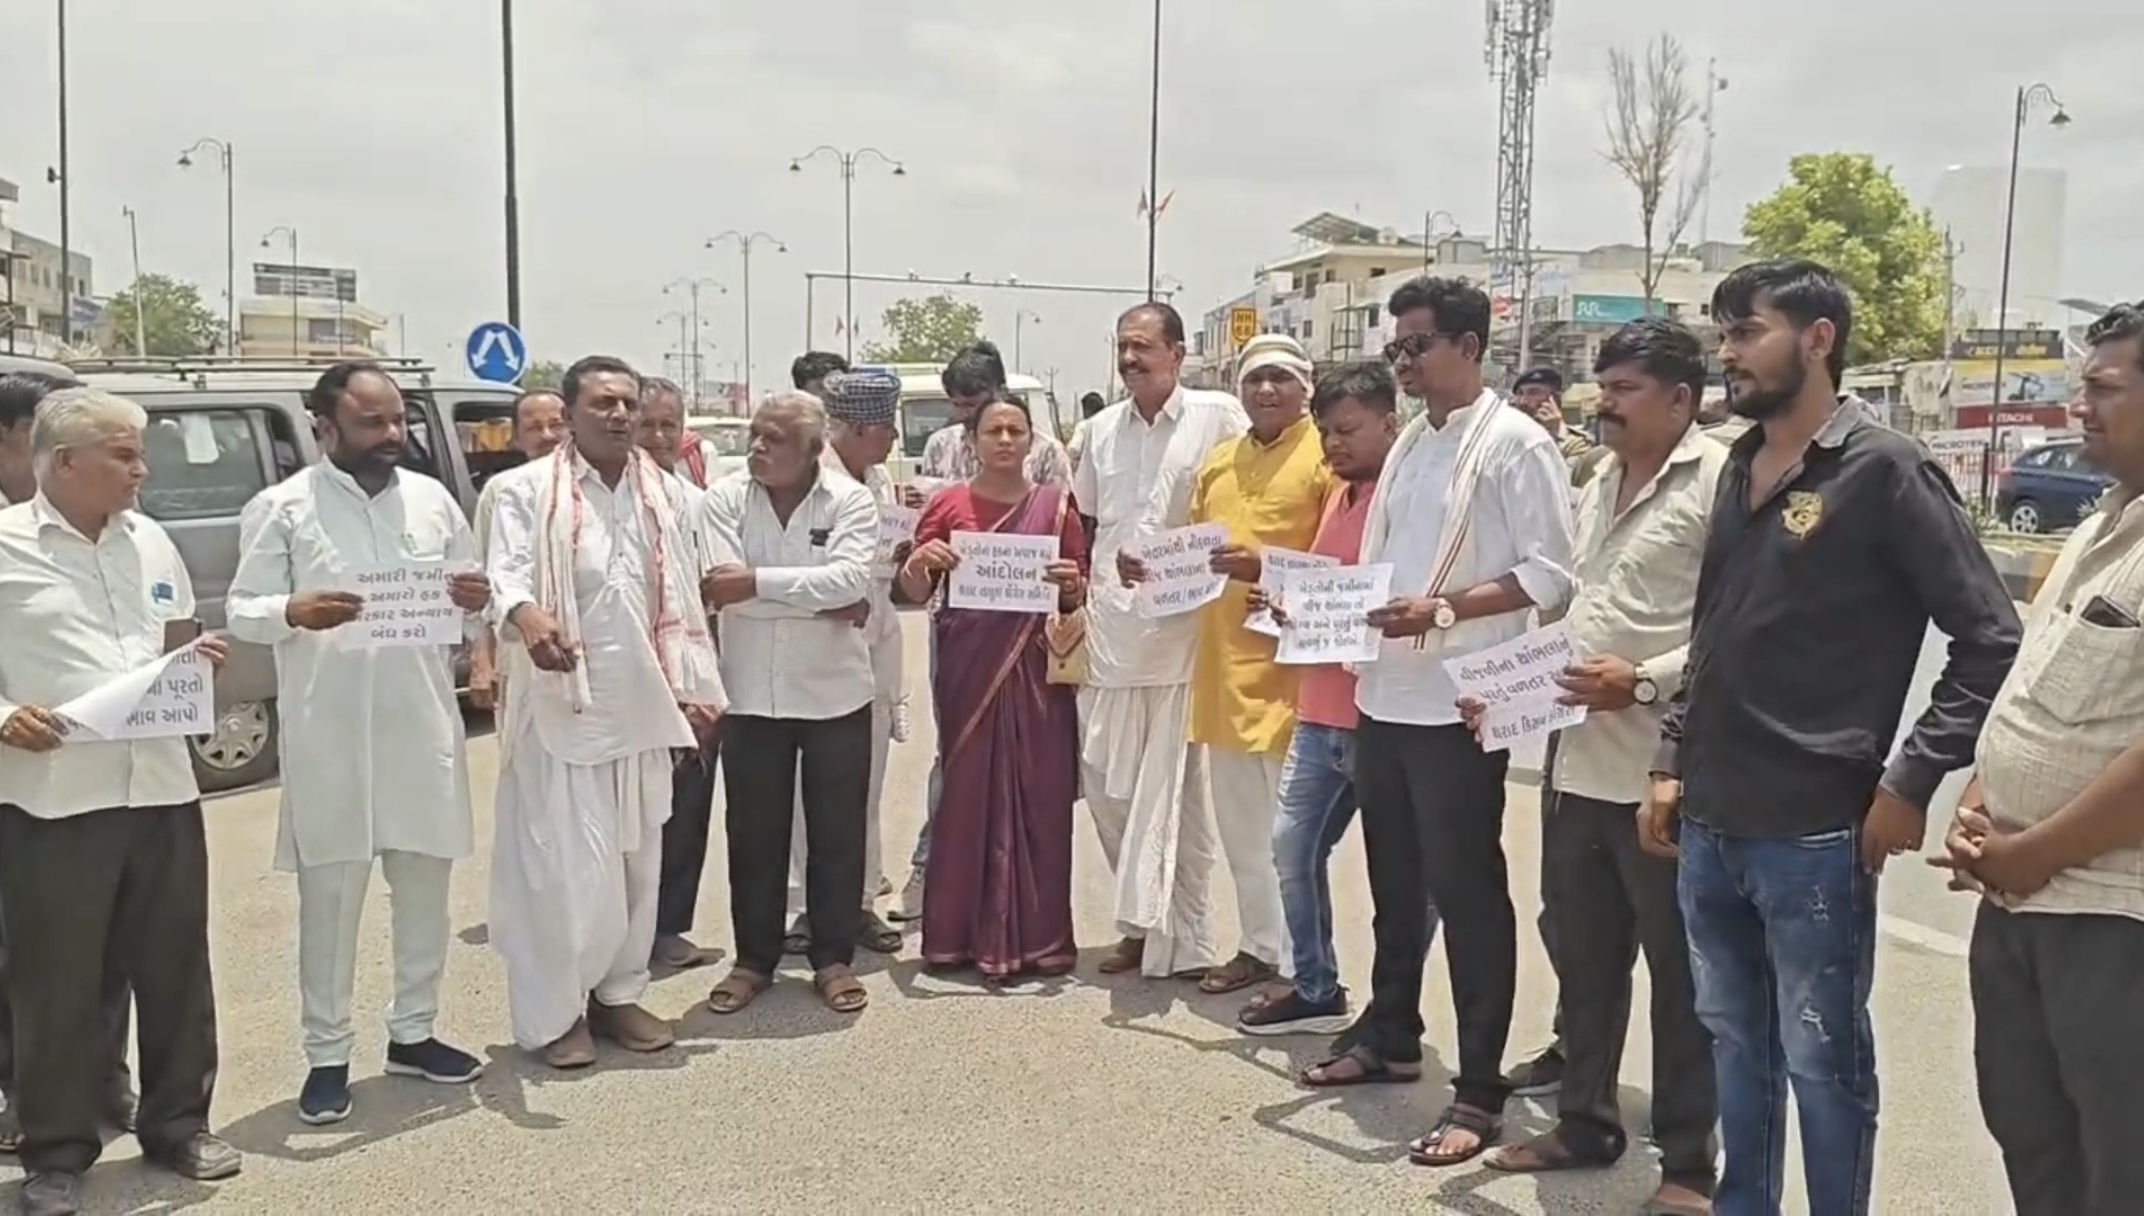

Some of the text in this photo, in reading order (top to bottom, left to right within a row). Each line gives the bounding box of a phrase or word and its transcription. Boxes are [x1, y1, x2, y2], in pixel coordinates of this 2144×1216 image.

[1236, 312, 1252, 323] NH
[1961, 380, 2007, 390] MICROTK
[357, 568, 406, 584] અમારી
[976, 561, 1037, 581] આંદોલન
[370, 586, 440, 602] અમારો હક
[357, 609, 395, 622] રકાર
[371, 623, 426, 639] બંધ કરો
[166, 671, 204, 701] પૂરતો
[126, 700, 198, 727] ભાવ આપો
